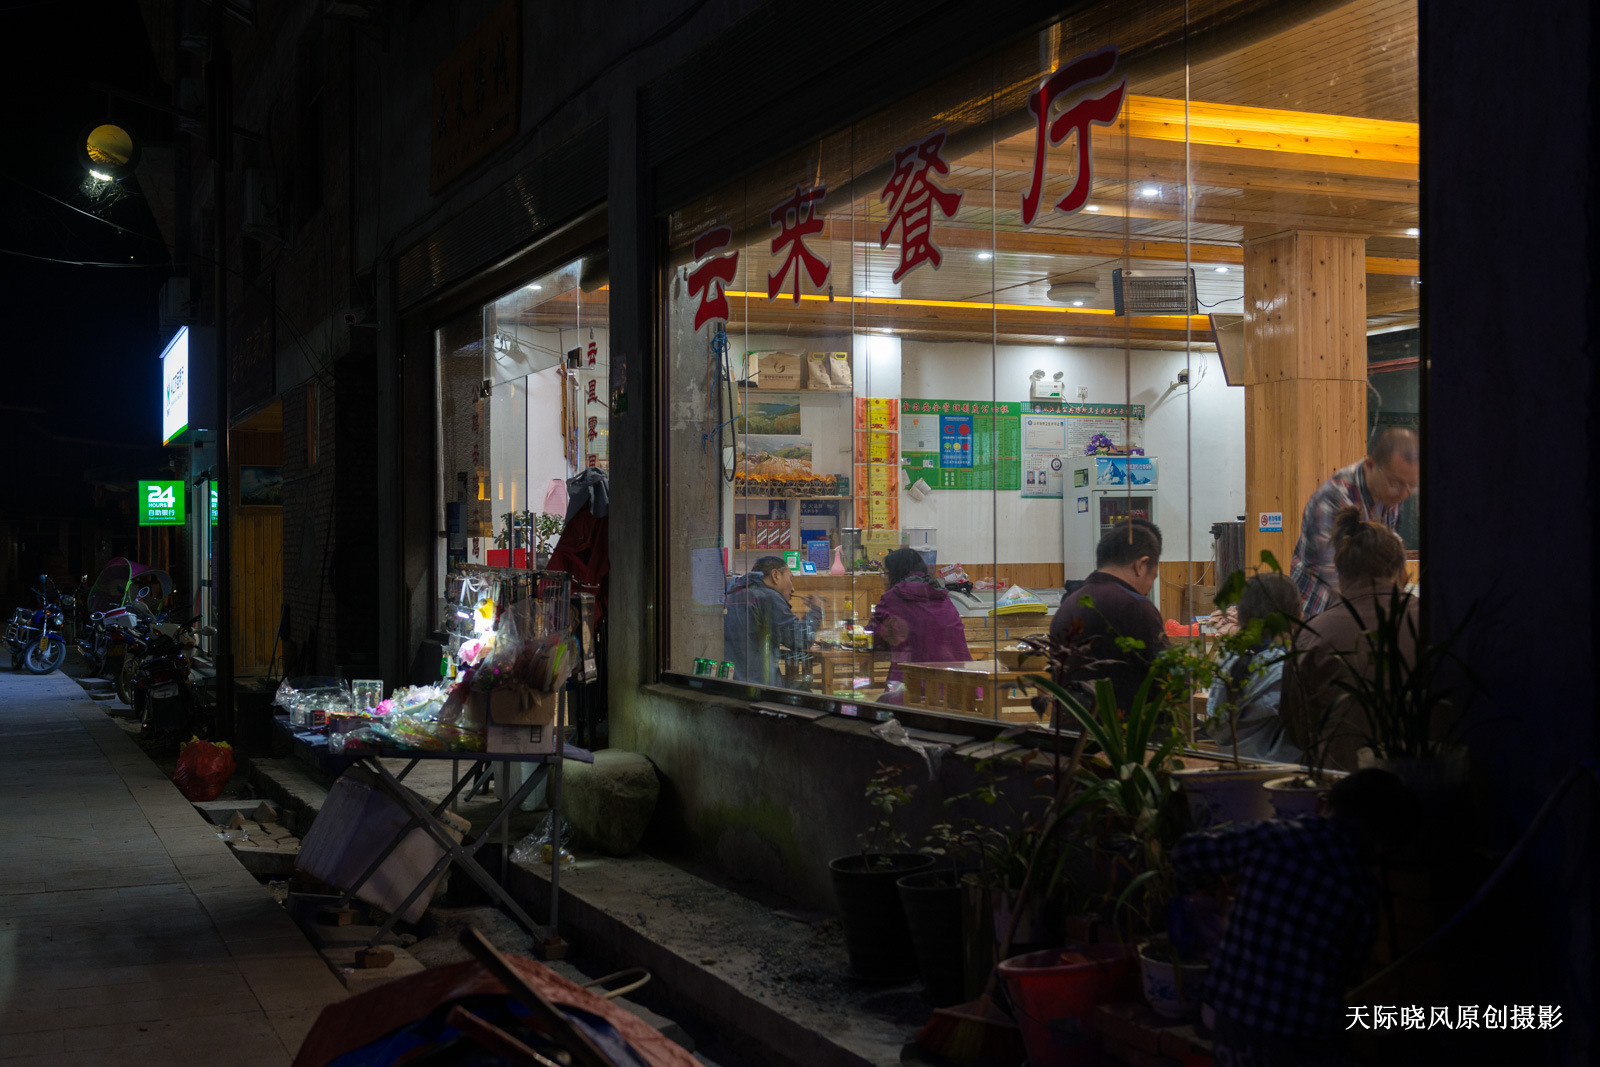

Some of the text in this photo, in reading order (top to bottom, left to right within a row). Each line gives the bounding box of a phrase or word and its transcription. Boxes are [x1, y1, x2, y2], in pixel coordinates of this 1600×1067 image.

[687, 44, 1128, 332] 云来餐厅
[148, 485, 176, 508] 24
